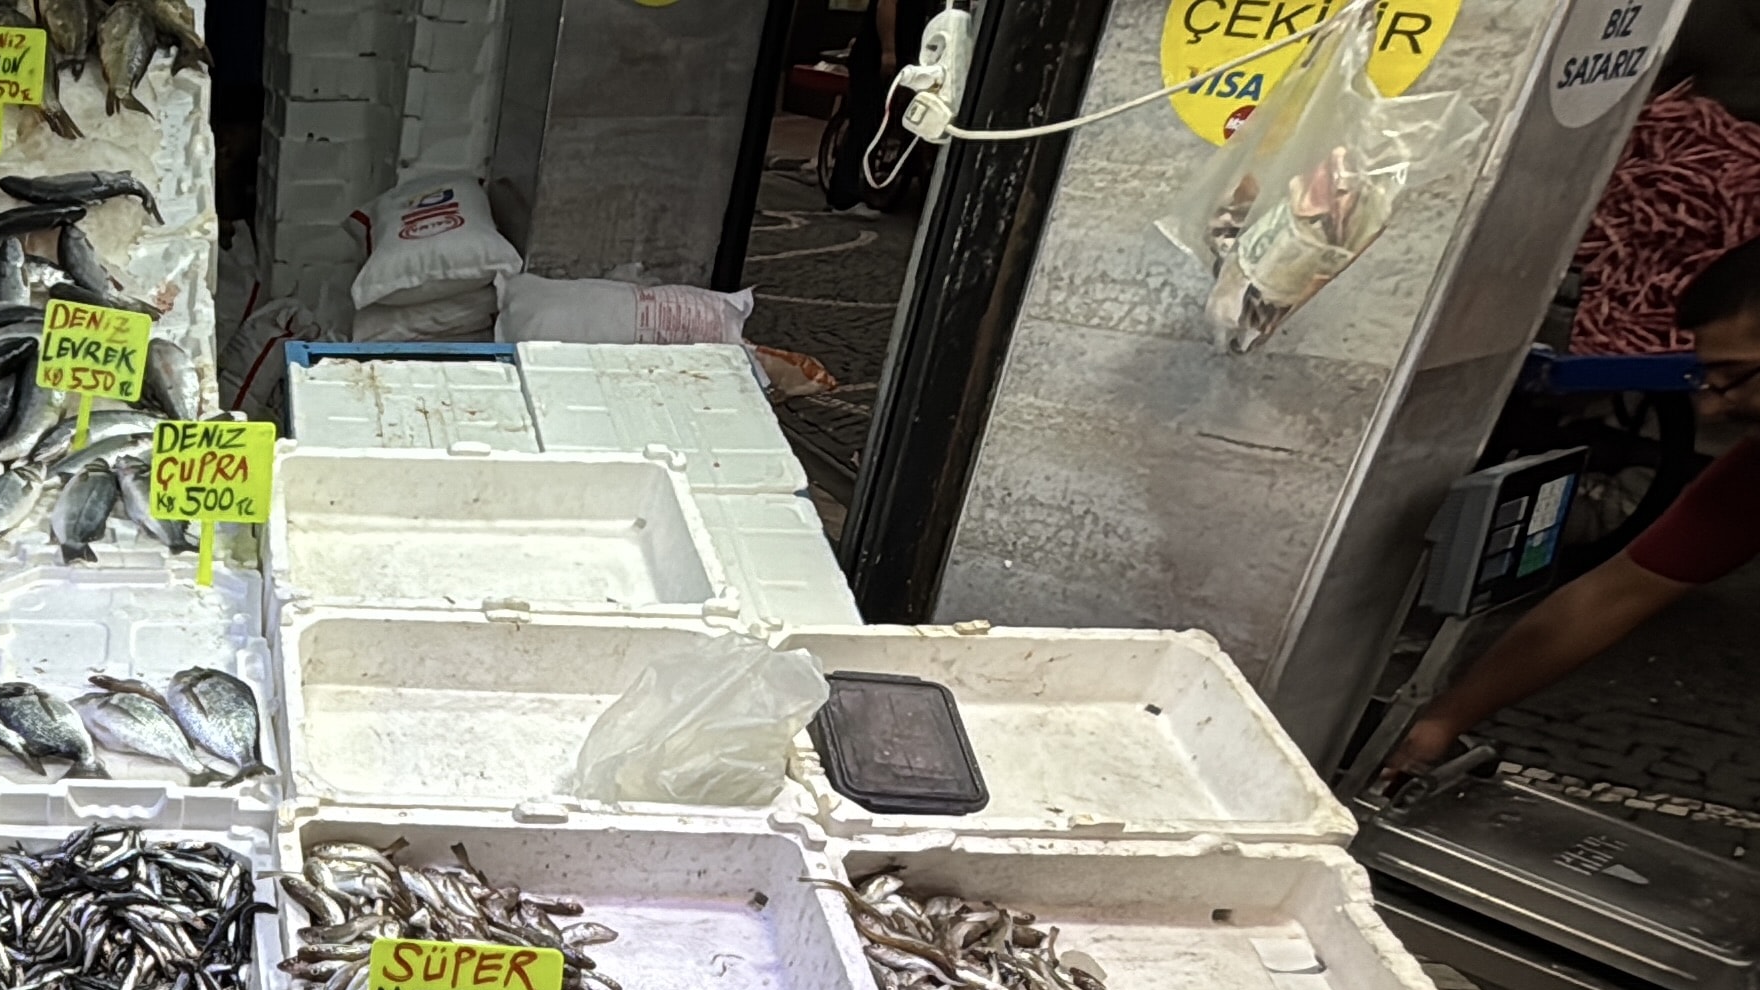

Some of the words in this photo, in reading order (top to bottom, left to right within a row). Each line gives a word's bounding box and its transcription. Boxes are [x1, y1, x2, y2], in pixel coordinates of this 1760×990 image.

[1187, 67, 1264, 102] VISA
[42, 331, 137, 374] LEVREK
[68, 367, 116, 391] 550
[156, 451, 249, 492] ÇUPRA
[179, 486, 235, 517] 500
